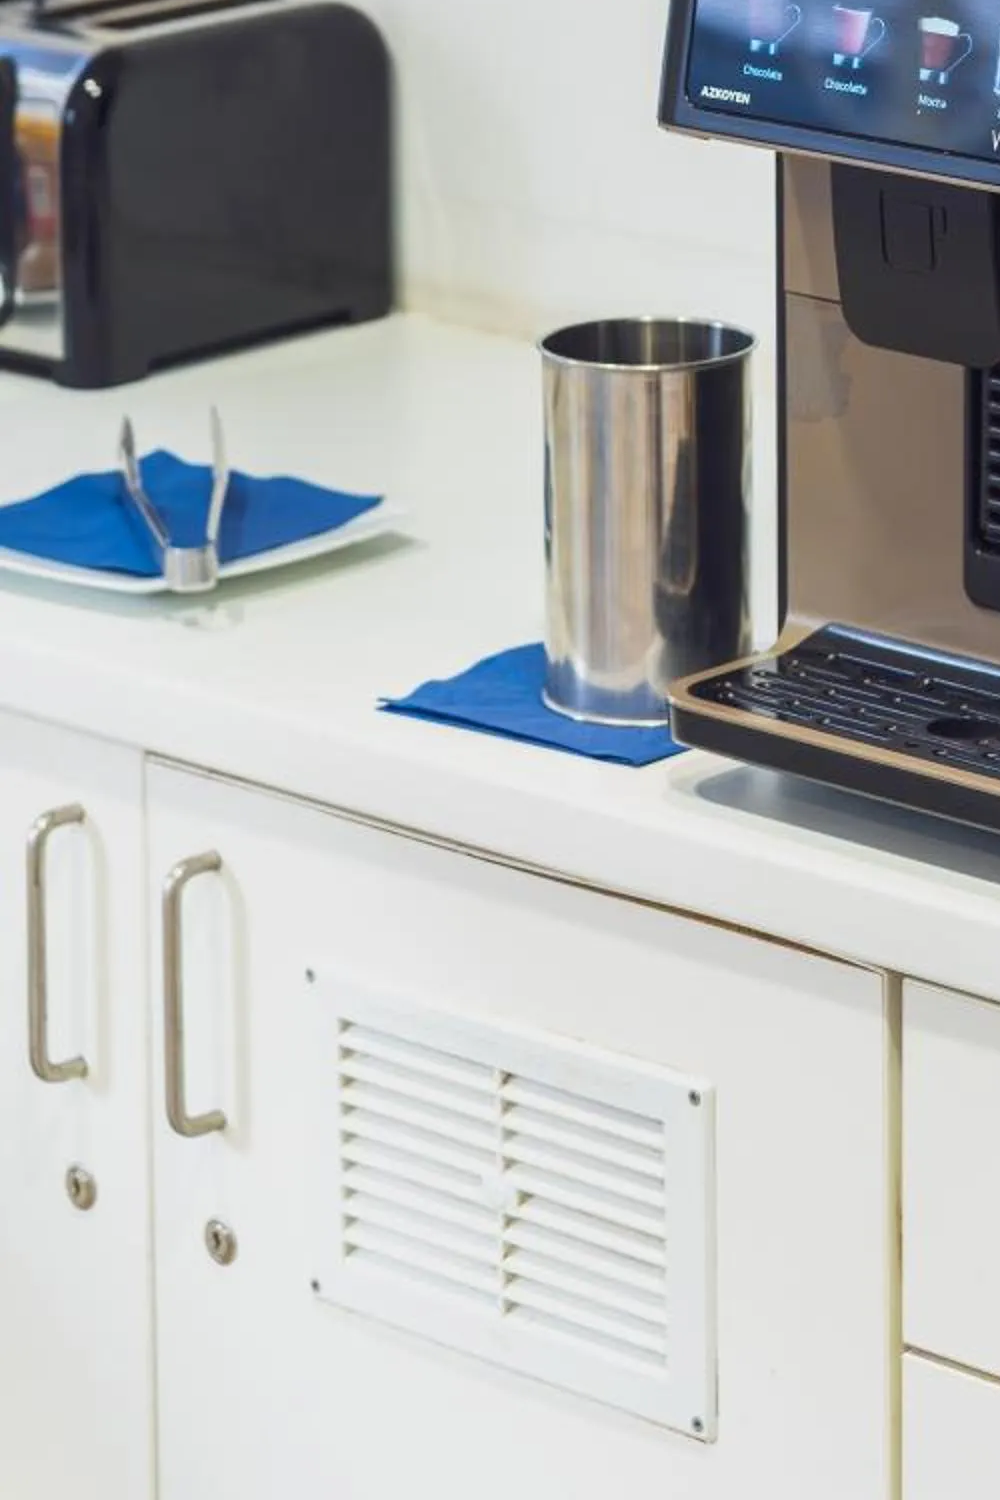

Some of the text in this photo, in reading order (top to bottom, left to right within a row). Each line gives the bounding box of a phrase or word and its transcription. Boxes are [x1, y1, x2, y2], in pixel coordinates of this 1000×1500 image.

[742, 62, 784, 82] Chocolate
[700, 84, 751, 105] AZKOYEN
[823, 76, 868, 96] Chocolate
